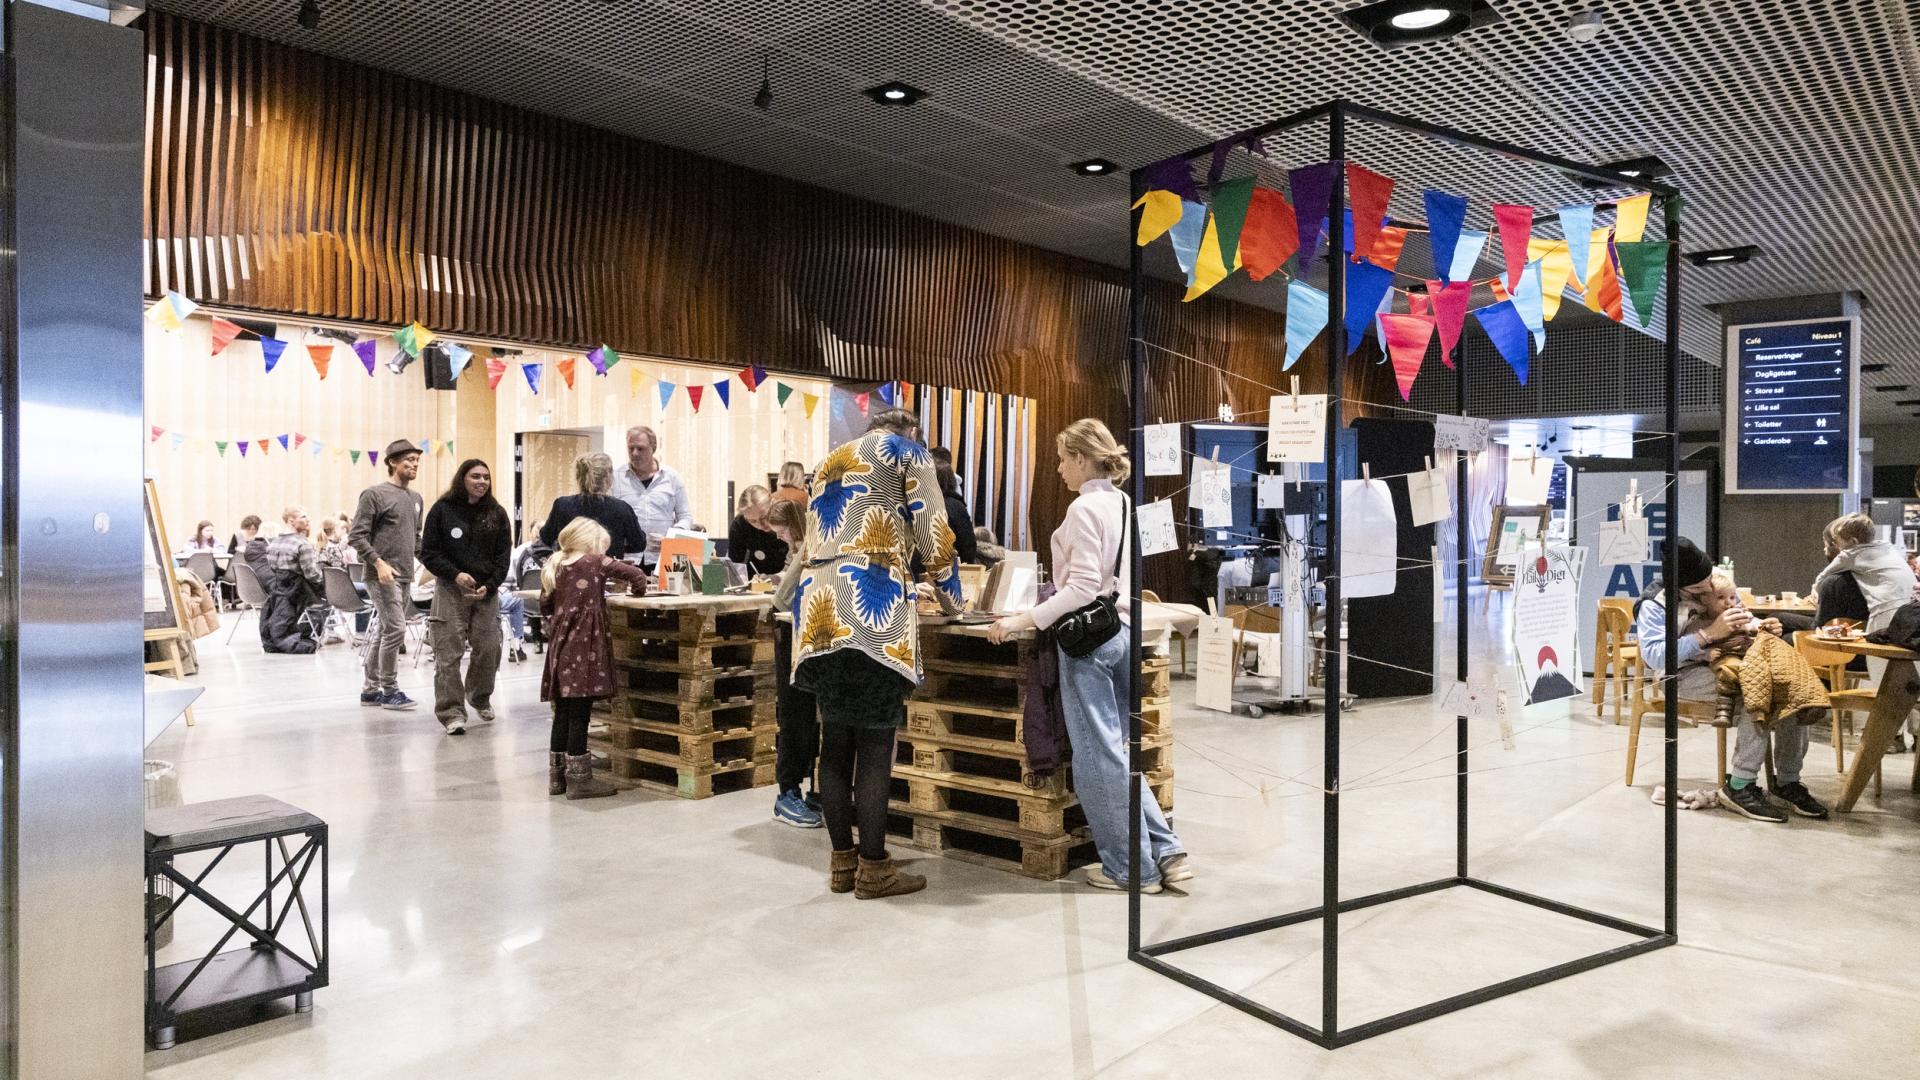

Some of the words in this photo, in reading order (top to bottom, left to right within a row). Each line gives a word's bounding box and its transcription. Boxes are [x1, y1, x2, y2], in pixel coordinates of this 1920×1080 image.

[1812, 332, 1837, 341] Niveau
[1745, 337, 1761, 345] Café
[1755, 352, 1803, 361] Reserveringer
[1755, 370, 1797, 378] Dagligstuen
[1754, 437, 1791, 445] Garderobe
